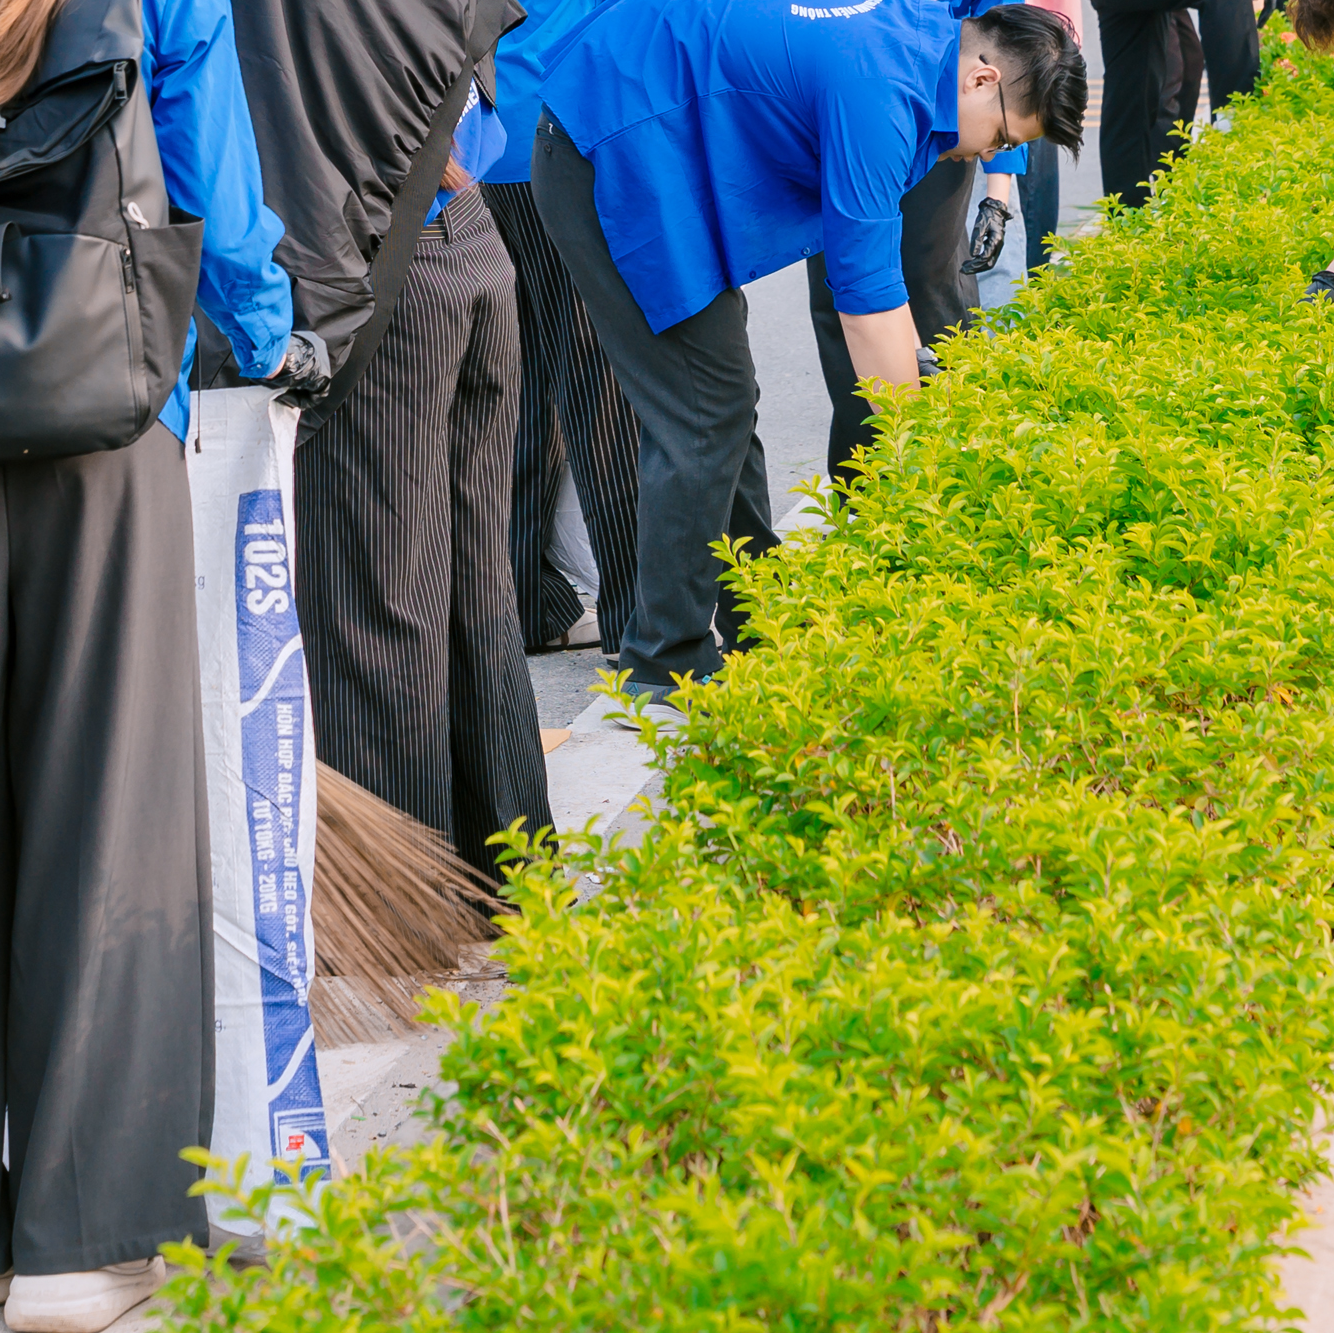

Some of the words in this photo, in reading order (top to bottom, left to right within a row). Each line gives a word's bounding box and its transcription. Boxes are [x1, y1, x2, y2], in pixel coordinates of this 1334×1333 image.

[791, 3, 832, 20] THÔNG
[244, 518, 290, 615] 102S
[194, 575, 206, 590] g
[258, 873, 278, 914] 20KG
[283, 871, 298, 901] HEO
